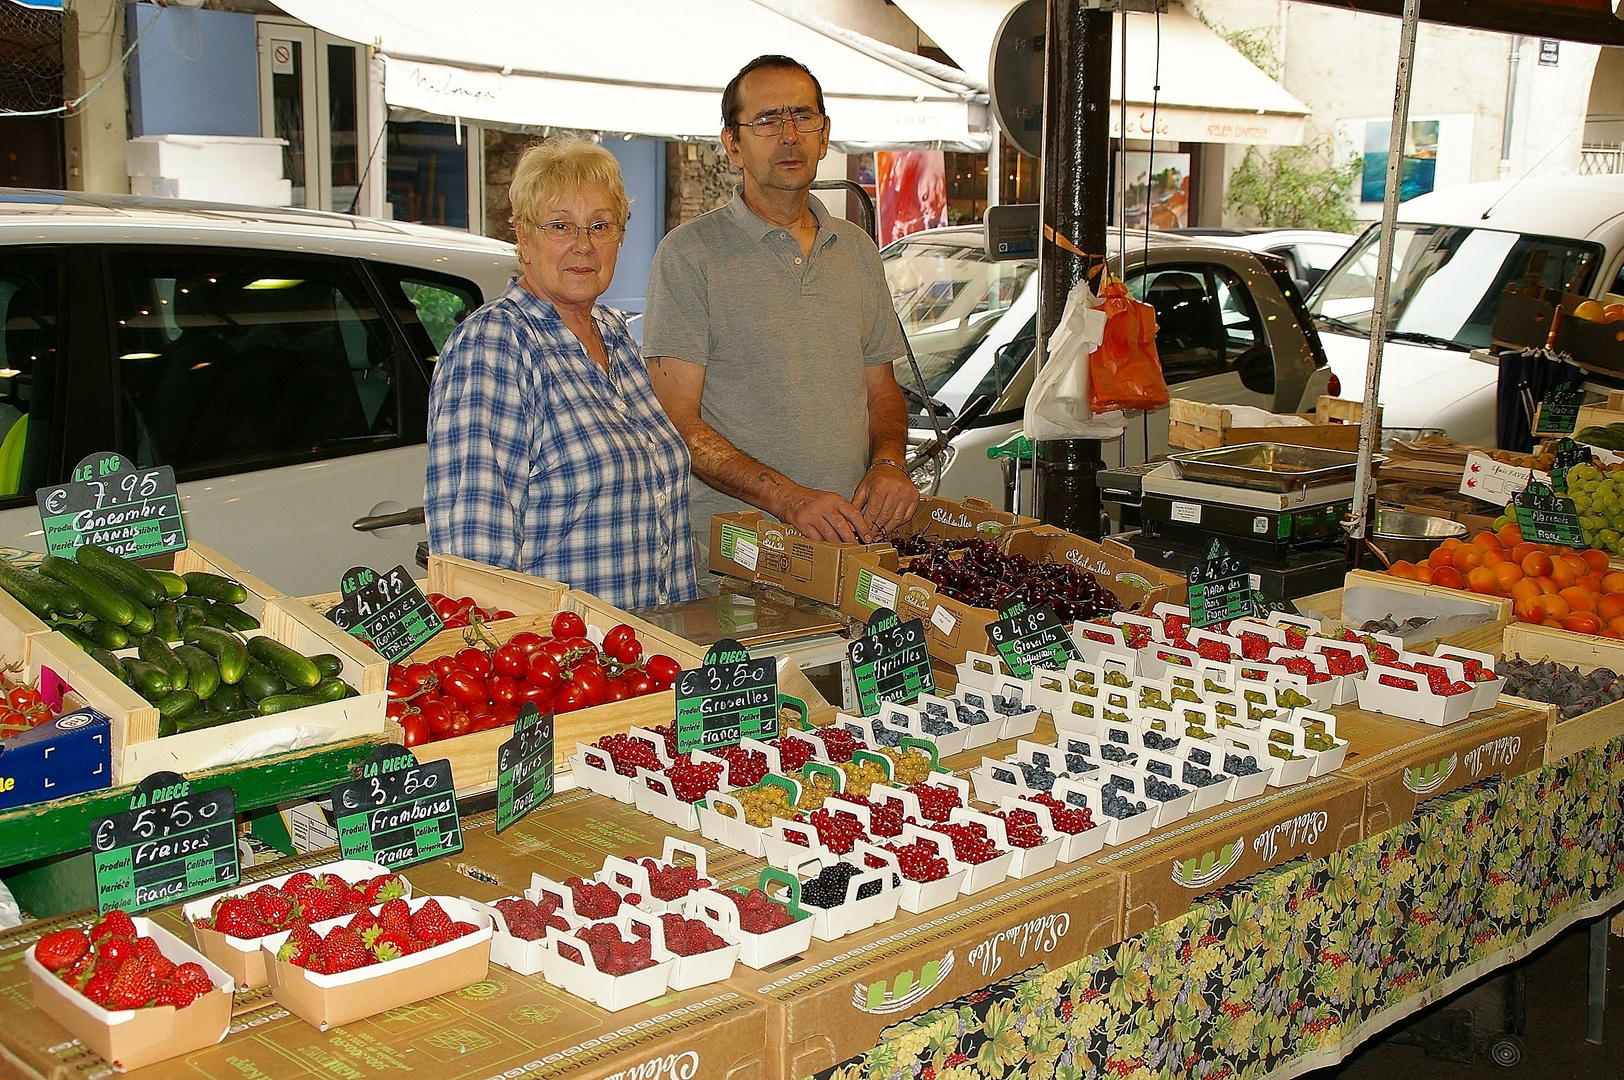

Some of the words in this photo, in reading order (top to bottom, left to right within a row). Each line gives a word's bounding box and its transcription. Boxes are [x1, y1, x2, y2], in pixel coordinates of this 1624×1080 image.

[75, 465, 93, 483] LE
[99, 455, 121, 475] KG
[1514, 493, 1523, 506] €
[1527, 486, 1537, 494] LE
[1540, 487, 1549, 496] KG
[45, 489, 67, 514] €
[72, 497, 167, 532] Concombre
[342, 577, 357, 594] LE
[357, 569, 373, 586] KG
[1189, 566, 1200, 583] €
[1008, 601, 1027, 617] PIECE
[878, 614, 898, 632] PIECE
[992, 625, 1003, 641] €
[704, 652, 717, 666] LA
[720, 650, 748, 664] PIECE
[852, 641, 864, 663] €
[681, 671, 698, 695] €
[922, 674, 931, 687] 1
[700, 690, 768, 713] Groseilles
[762, 720, 772, 731] 1
[701, 728, 740, 744] France
[363, 762, 378, 778] LA
[382, 753, 414, 774] PIECE
[500, 748, 509, 771] €
[130, 794, 147, 810] LA
[152, 781, 190, 804] PIECE
[342, 788, 359, 809] €
[96, 819, 116, 851] €
[341, 823, 367, 837] Produit
[415, 825, 439, 837] Calibre
[1289, 810, 1328, 848] Soleil
[344, 841, 369, 856] Variété
[440, 831, 453, 847] 1
[99, 858, 131, 873] Produit
[135, 830, 210, 864] Fraises
[186, 857, 213, 871] Calibre
[100, 877, 130, 895] Variété
[188, 875, 215, 888] Catégorie
[220, 866, 235, 880] 1
[1019, 911, 1071, 959] Soleil
